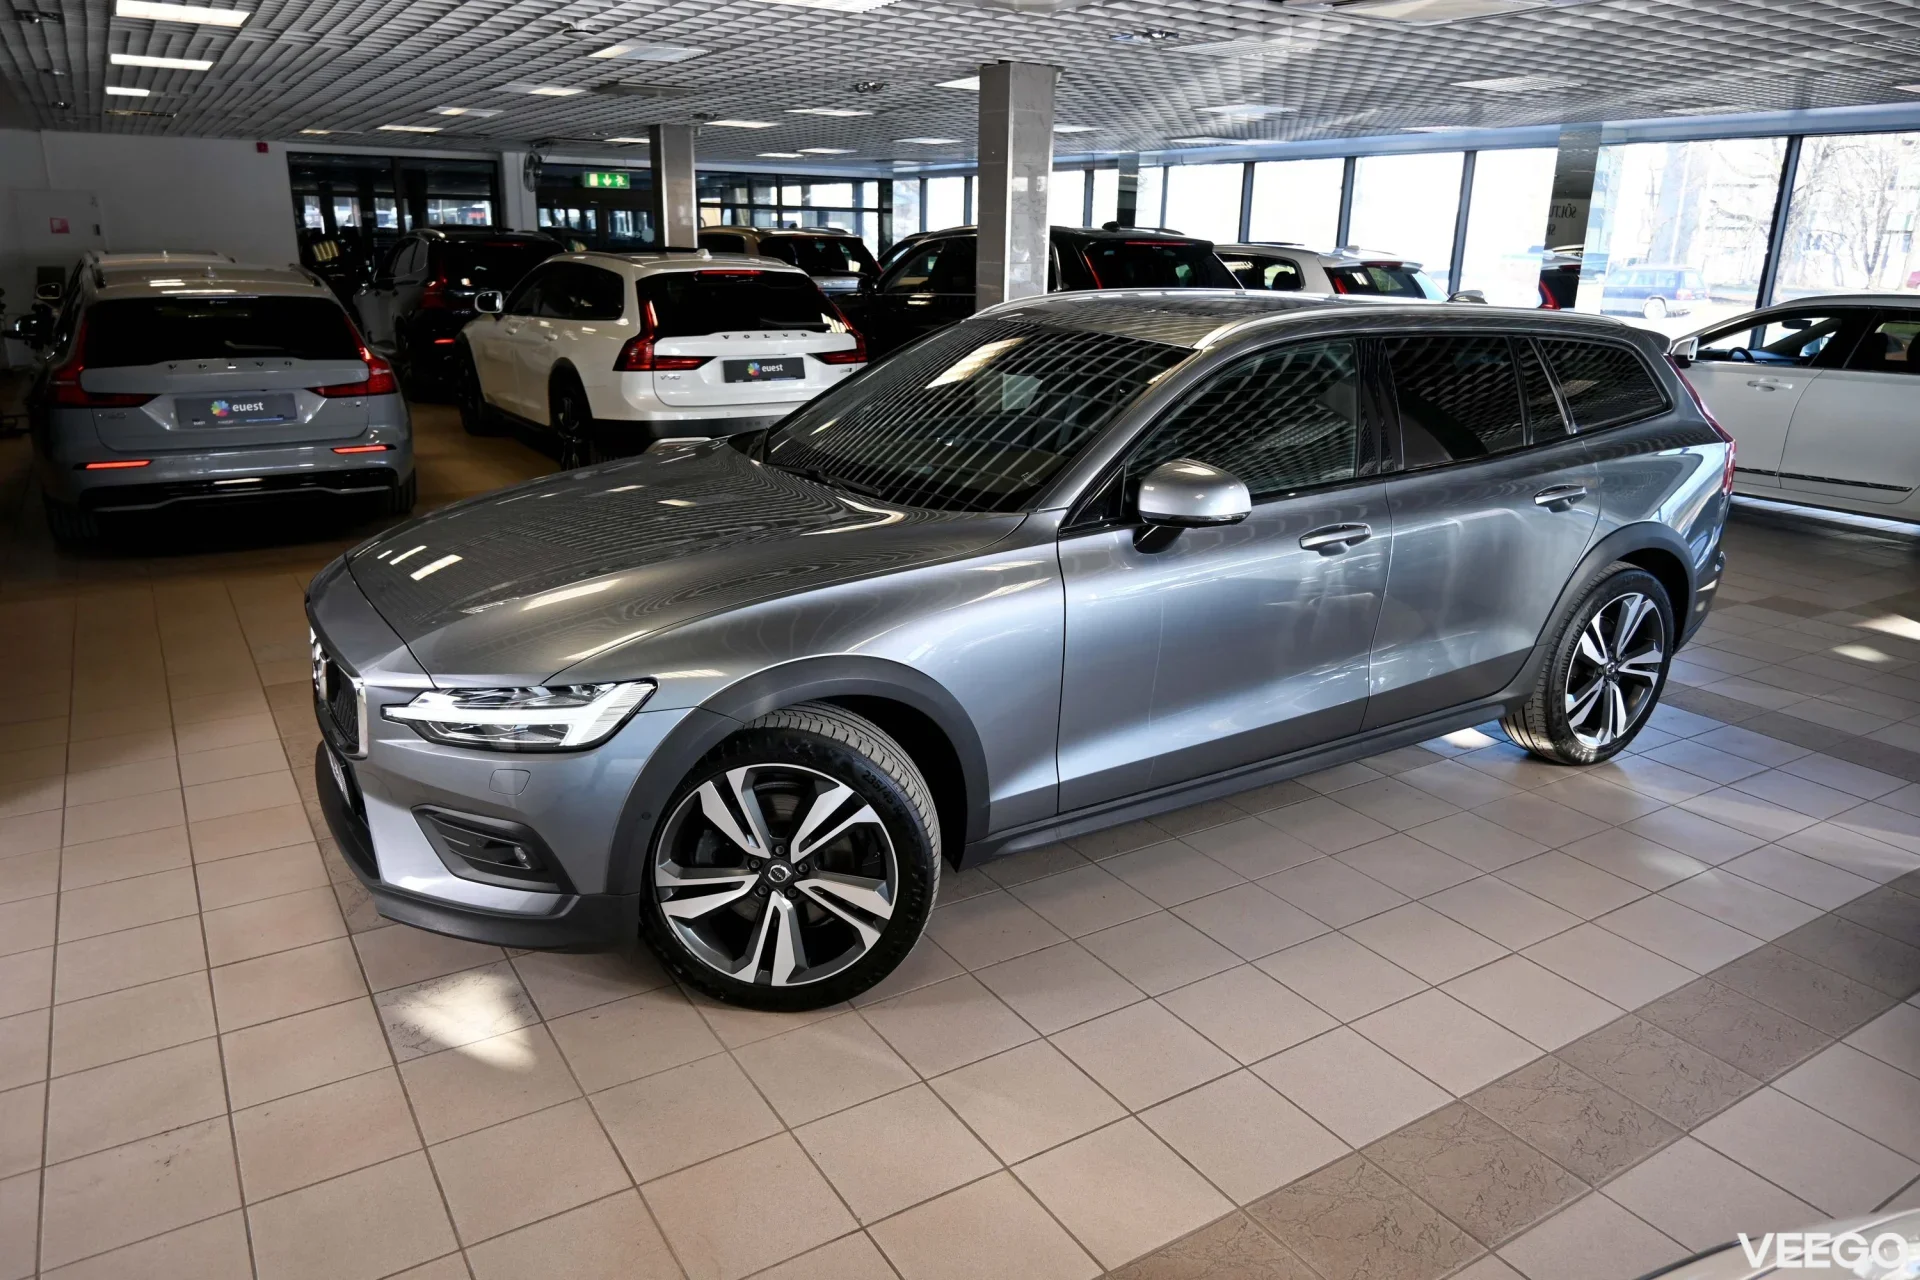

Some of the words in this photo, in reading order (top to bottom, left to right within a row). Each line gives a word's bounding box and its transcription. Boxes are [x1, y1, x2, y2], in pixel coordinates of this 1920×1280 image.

[722, 332, 808, 341] VOLVO
[761, 363, 784, 372] euest
[232, 401, 264, 412] euest
